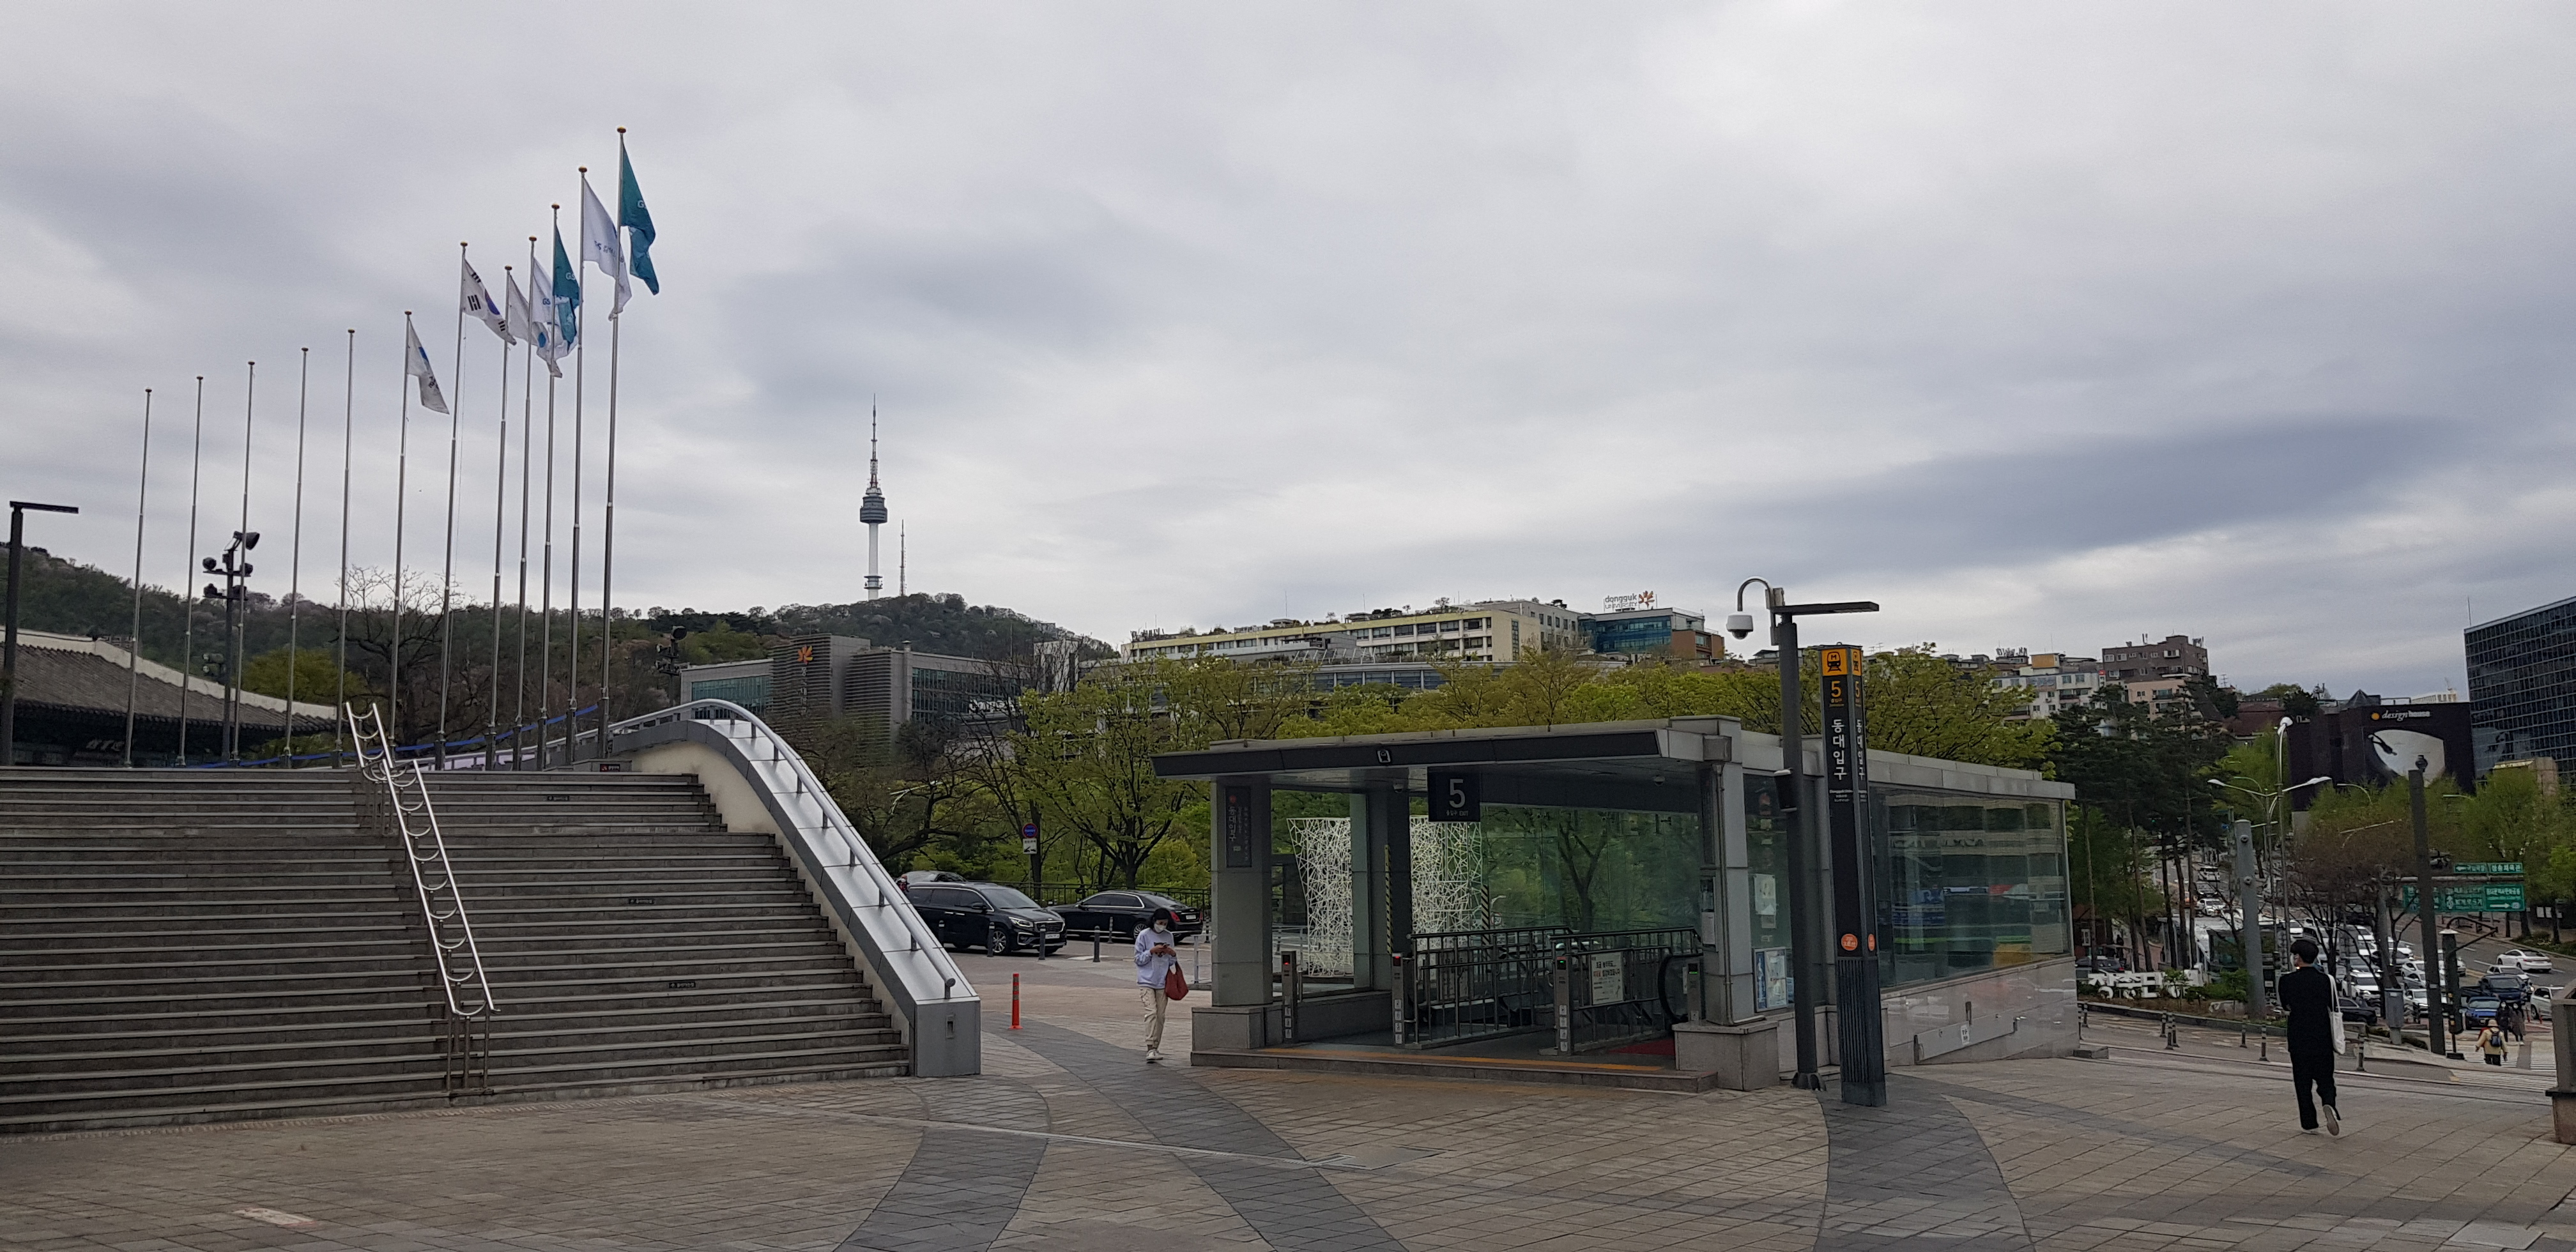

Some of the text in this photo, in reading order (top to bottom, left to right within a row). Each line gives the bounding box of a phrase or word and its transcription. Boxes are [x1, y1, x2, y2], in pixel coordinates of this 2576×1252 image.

[1604, 593, 1637, 603] dongguk
[1831, 680, 1841, 698] 5
[1855, 680, 1860, 698] 5
[1831, 718, 1848, 781] 동대입구
[1856, 719, 1865, 781] 동대입구
[1449, 778, 1466, 808] 5
[1229, 806, 1237, 842] 동대입구
